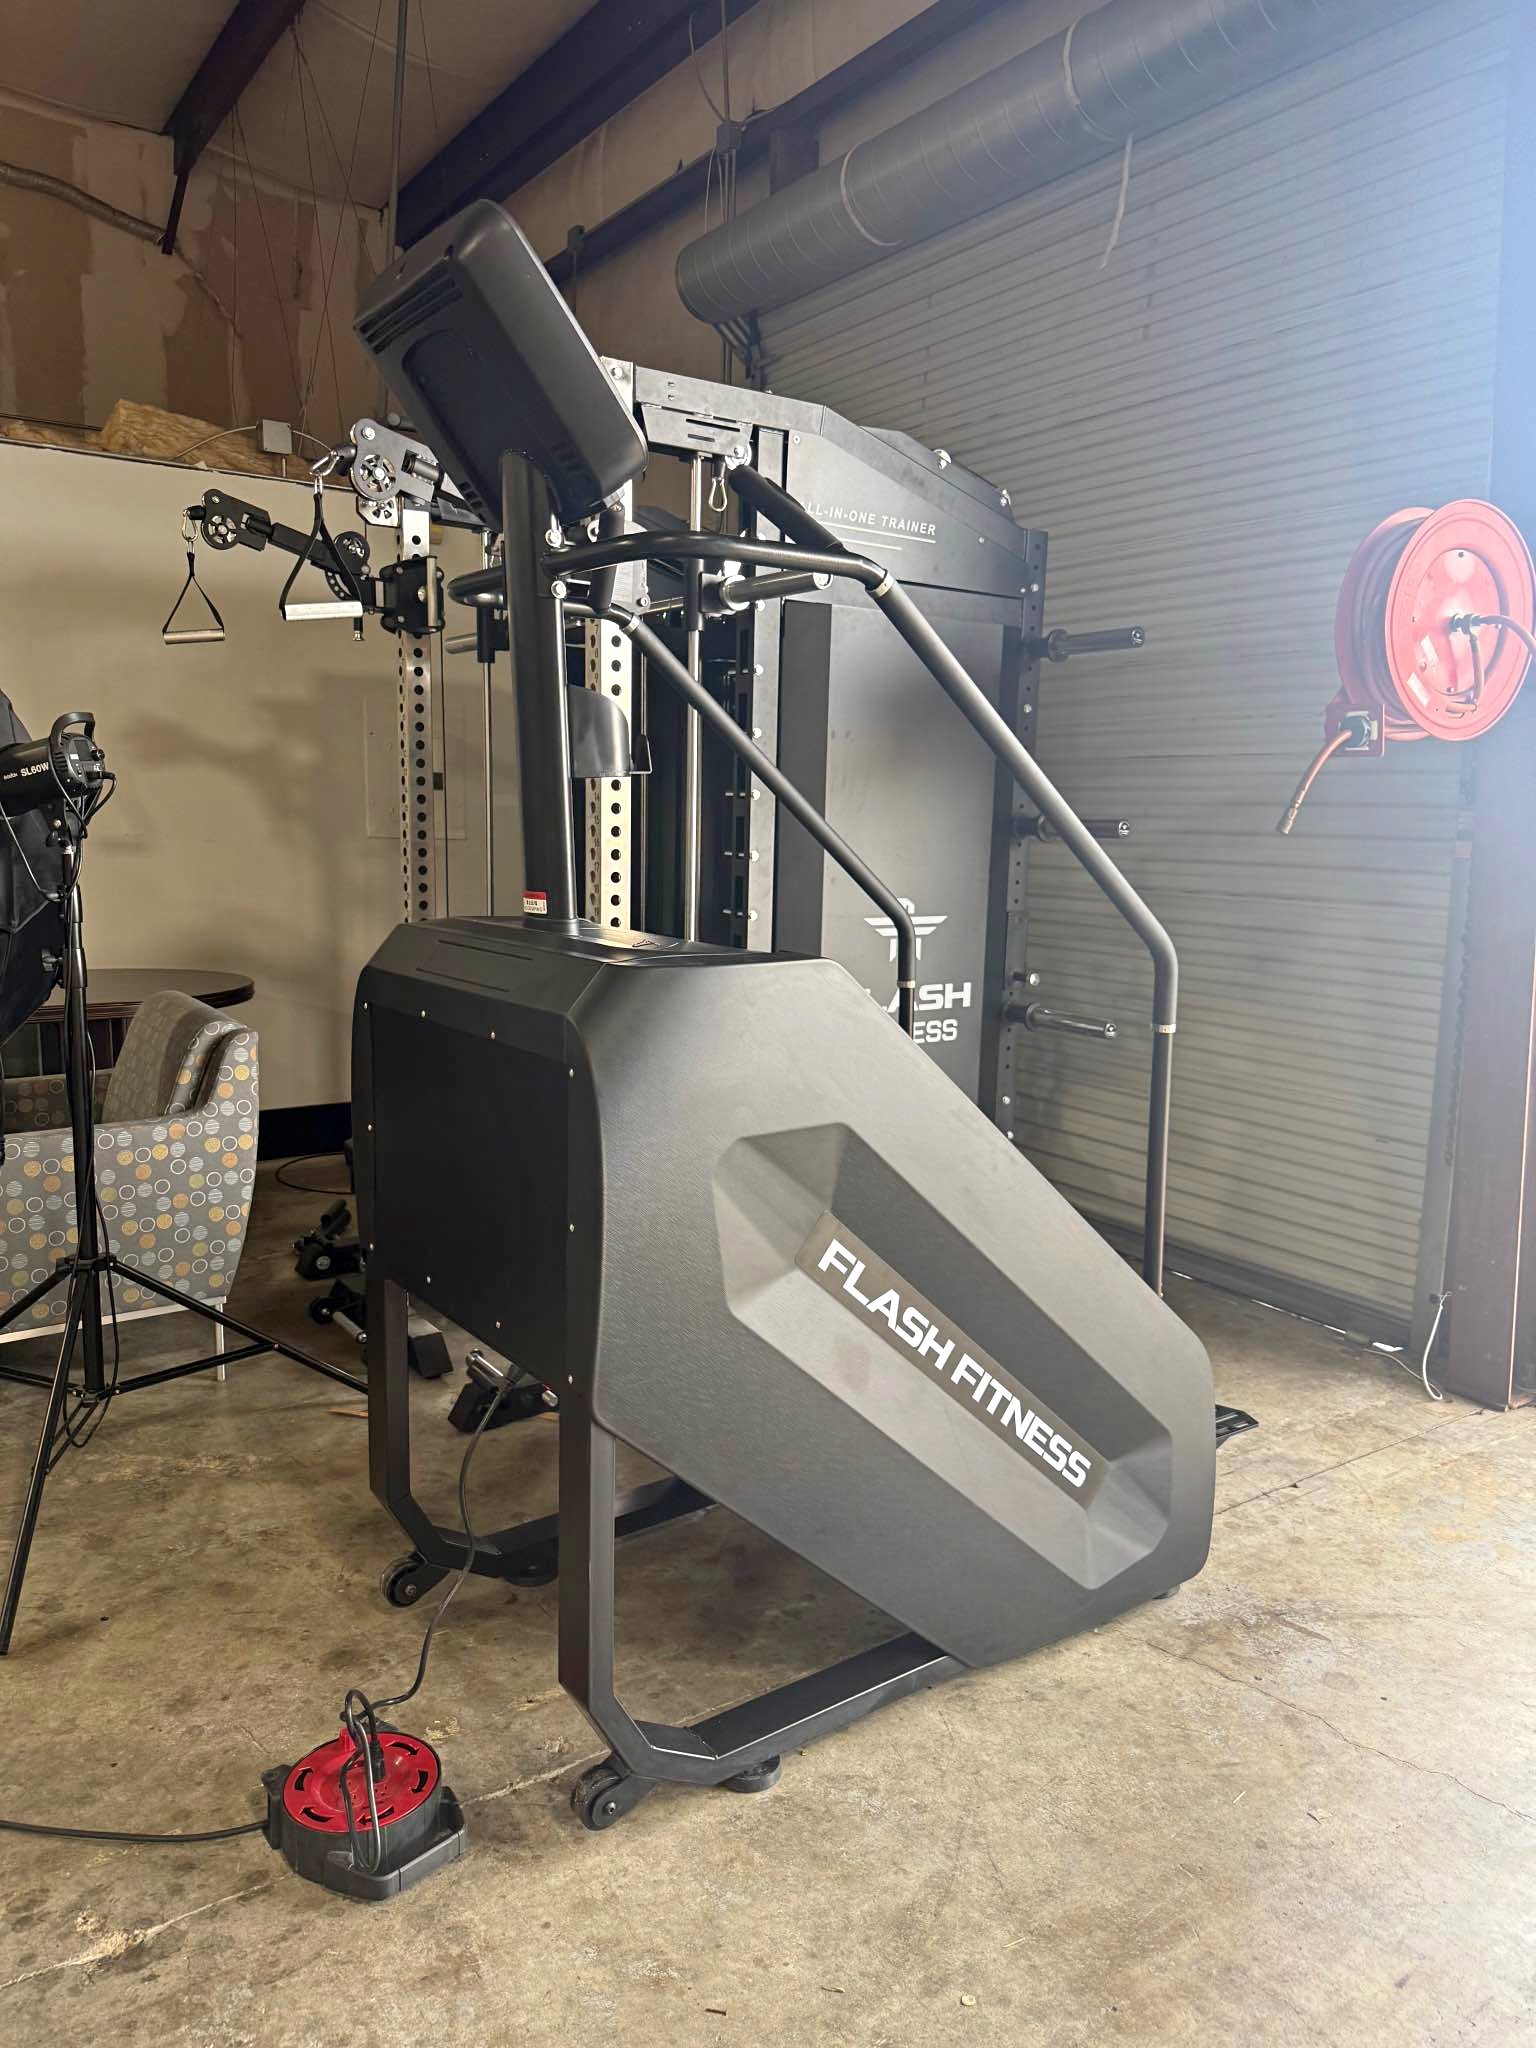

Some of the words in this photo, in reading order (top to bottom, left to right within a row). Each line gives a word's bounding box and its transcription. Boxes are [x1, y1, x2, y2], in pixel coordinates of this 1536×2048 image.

[801, 501, 876, 525] LL-IN-ONE
[881, 515, 936, 536] TRAINER
[20, 761, 49, 777] SL60W
[817, 1238, 956, 1371] FLASH
[950, 1353, 1092, 1488] FITNESS
